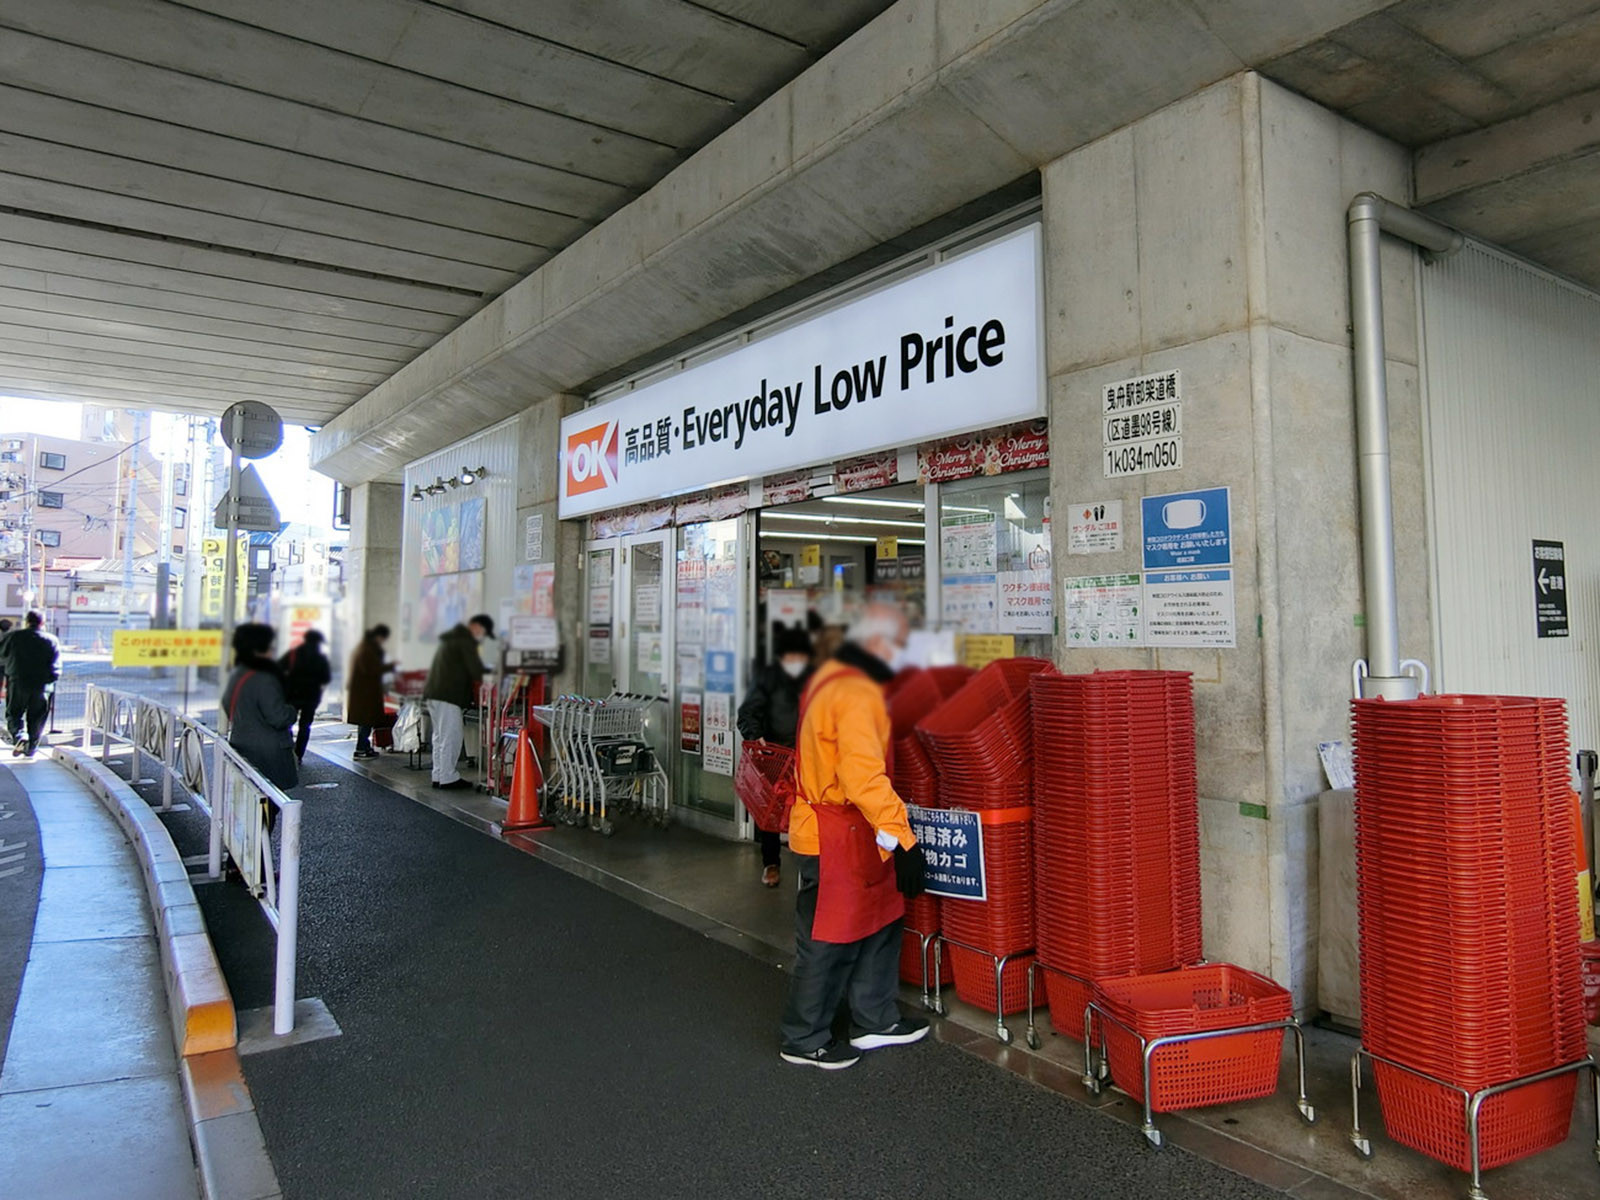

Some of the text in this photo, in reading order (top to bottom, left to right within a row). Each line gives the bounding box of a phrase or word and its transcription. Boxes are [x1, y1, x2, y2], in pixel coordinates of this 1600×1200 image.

[814, 355, 887, 415] Low
[900, 316, 1005, 391] Price
[1107, 374, 1176, 411] 曳舟駅部架道橋
[571, 421, 617, 486] OK
[1007, 436, 1044, 452] Merry
[936, 452, 967, 466] Merry
[1001, 448, 1049, 467] Christmas
[1108, 441, 1177, 474] 1k034m050
[929, 463, 973, 479] Christmas
[914, 824, 968, 848] 消毒済み
[921, 847, 968, 868] 物カゴ
